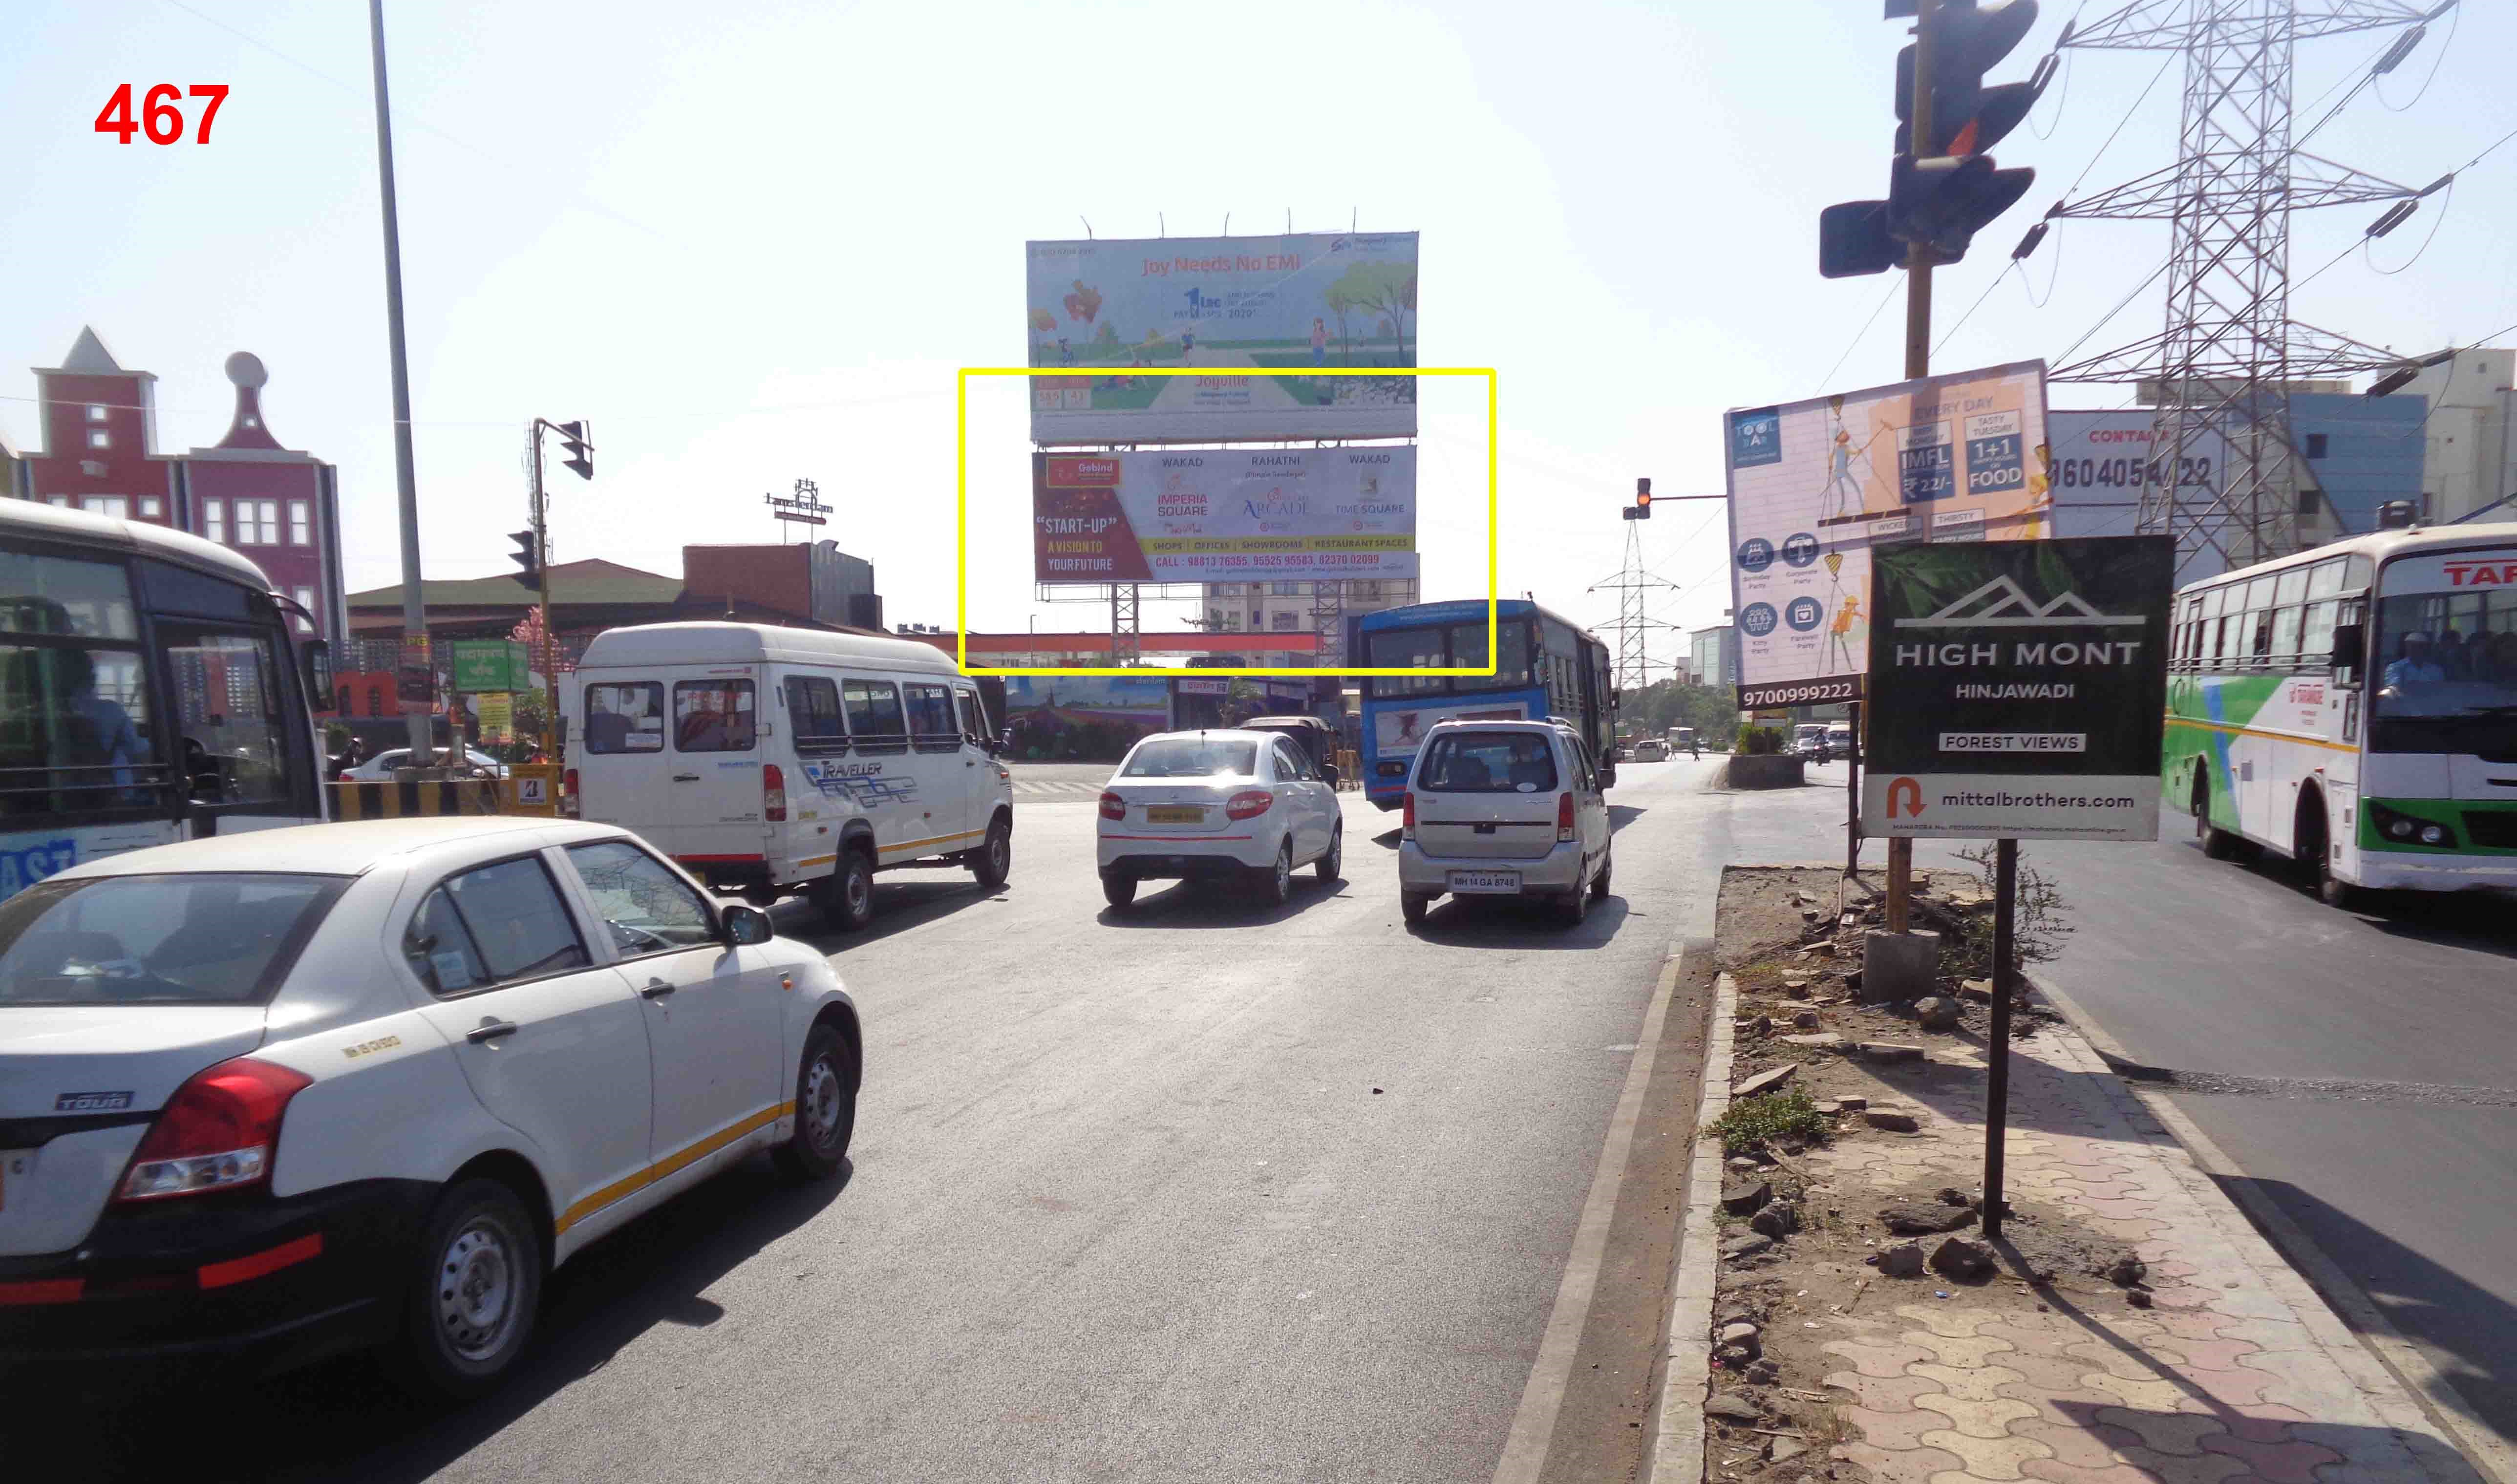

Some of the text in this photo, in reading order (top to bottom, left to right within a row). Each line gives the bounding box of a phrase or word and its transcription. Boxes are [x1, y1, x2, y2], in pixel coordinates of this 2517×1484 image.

[1141, 254, 1301, 277] Joy Needs No EMI
[1195, 375, 1250, 390] Joyville
[1915, 396, 1993, 418] EVERY DAY
[1978, 415, 2005, 425] TASTY
[1735, 421, 1775, 438] TOOL
[1974, 423, 2013, 436] TUESDAY
[1975, 438, 2010, 458] 1+1
[1162, 457, 1203, 467] WAKAD
[1251, 456, 1301, 466] RAHATNI
[1349, 454, 1391, 465] WAKAD
[1901, 446, 1949, 469] IMFL
[1078, 461, 1113, 473] Gobind
[2051, 457, 2211, 488] 960405422
[1920, 476, 1952, 492] 22/-
[1969, 467, 2023, 488] FOOD
[1157, 494, 1208, 505] IMPERIA
[1157, 506, 1208, 516] SQUARE
[1336, 504, 1405, 514] TIME SQUARE
[1938, 513, 1974, 524] THIRSTY
[1877, 521, 1911, 532] WICKED
[1054, 539, 1089, 553] VISION
[1153, 542, 1183, 551] SHOPS
[1195, 541, 1230, 550] OFFICES
[1242, 540, 1303, 549] SHOWROOMS
[1315, 538, 1408, 548] RESTAURANT SPACES
[1047, 558, 1113, 571] YOUR FUTURE
[1155, 556, 1179, 567] CALL
[1188, 556, 1216, 567] 98813
[1896, 641, 2142, 666] HIGH MONT
[1744, 683, 1853, 706] 9700999222
[1956, 684, 2075, 699] HINJAWADI
[1945, 736, 2079, 749] FOREST VIEWS
[821, 760, 883, 779] TRAVELLER
[1942, 791, 2134, 808] mittalbrothers.com
[1454, 877, 1468, 886] MH
[1470, 877, 1478, 886] 14
[1479, 878, 1493, 887] GA
[58, 1097, 127, 1109] TOUR
